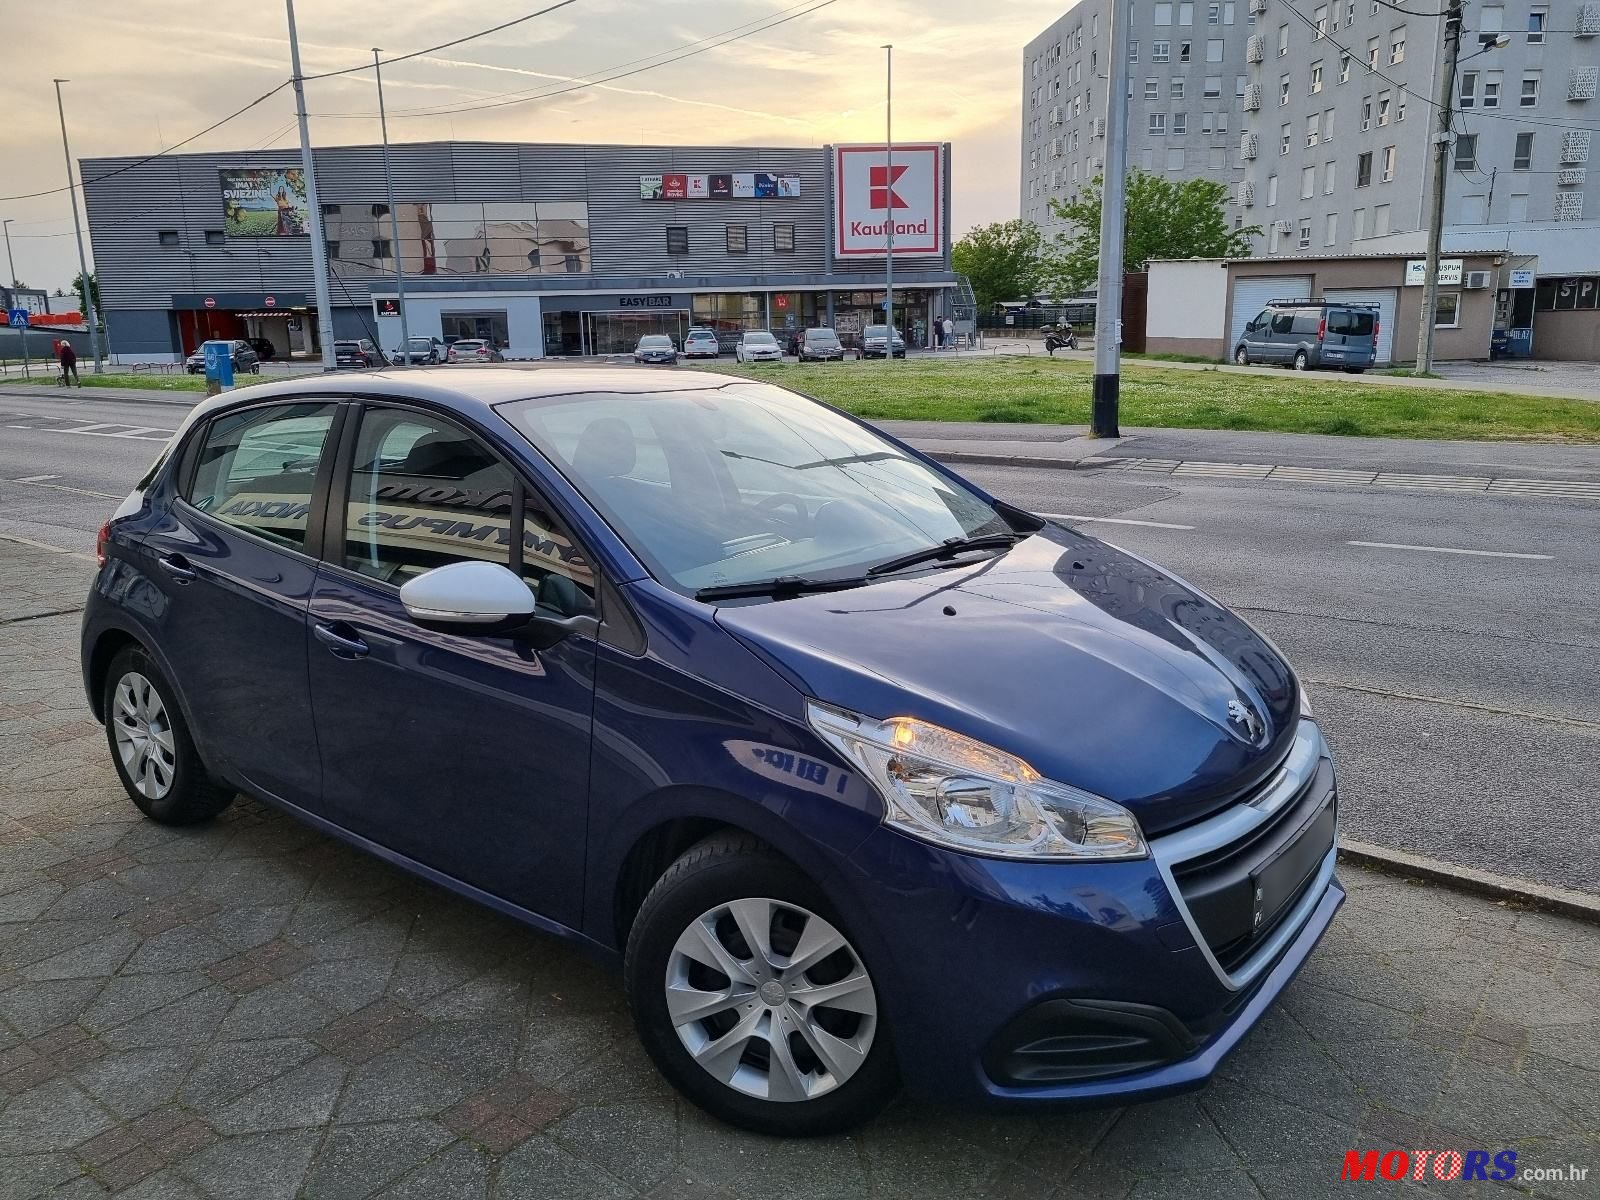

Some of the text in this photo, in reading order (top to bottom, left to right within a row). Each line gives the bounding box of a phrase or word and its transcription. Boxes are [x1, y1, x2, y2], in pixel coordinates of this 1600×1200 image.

[851, 219, 927, 236] Kaufland
[620, 296, 670, 306] EASY BAR
